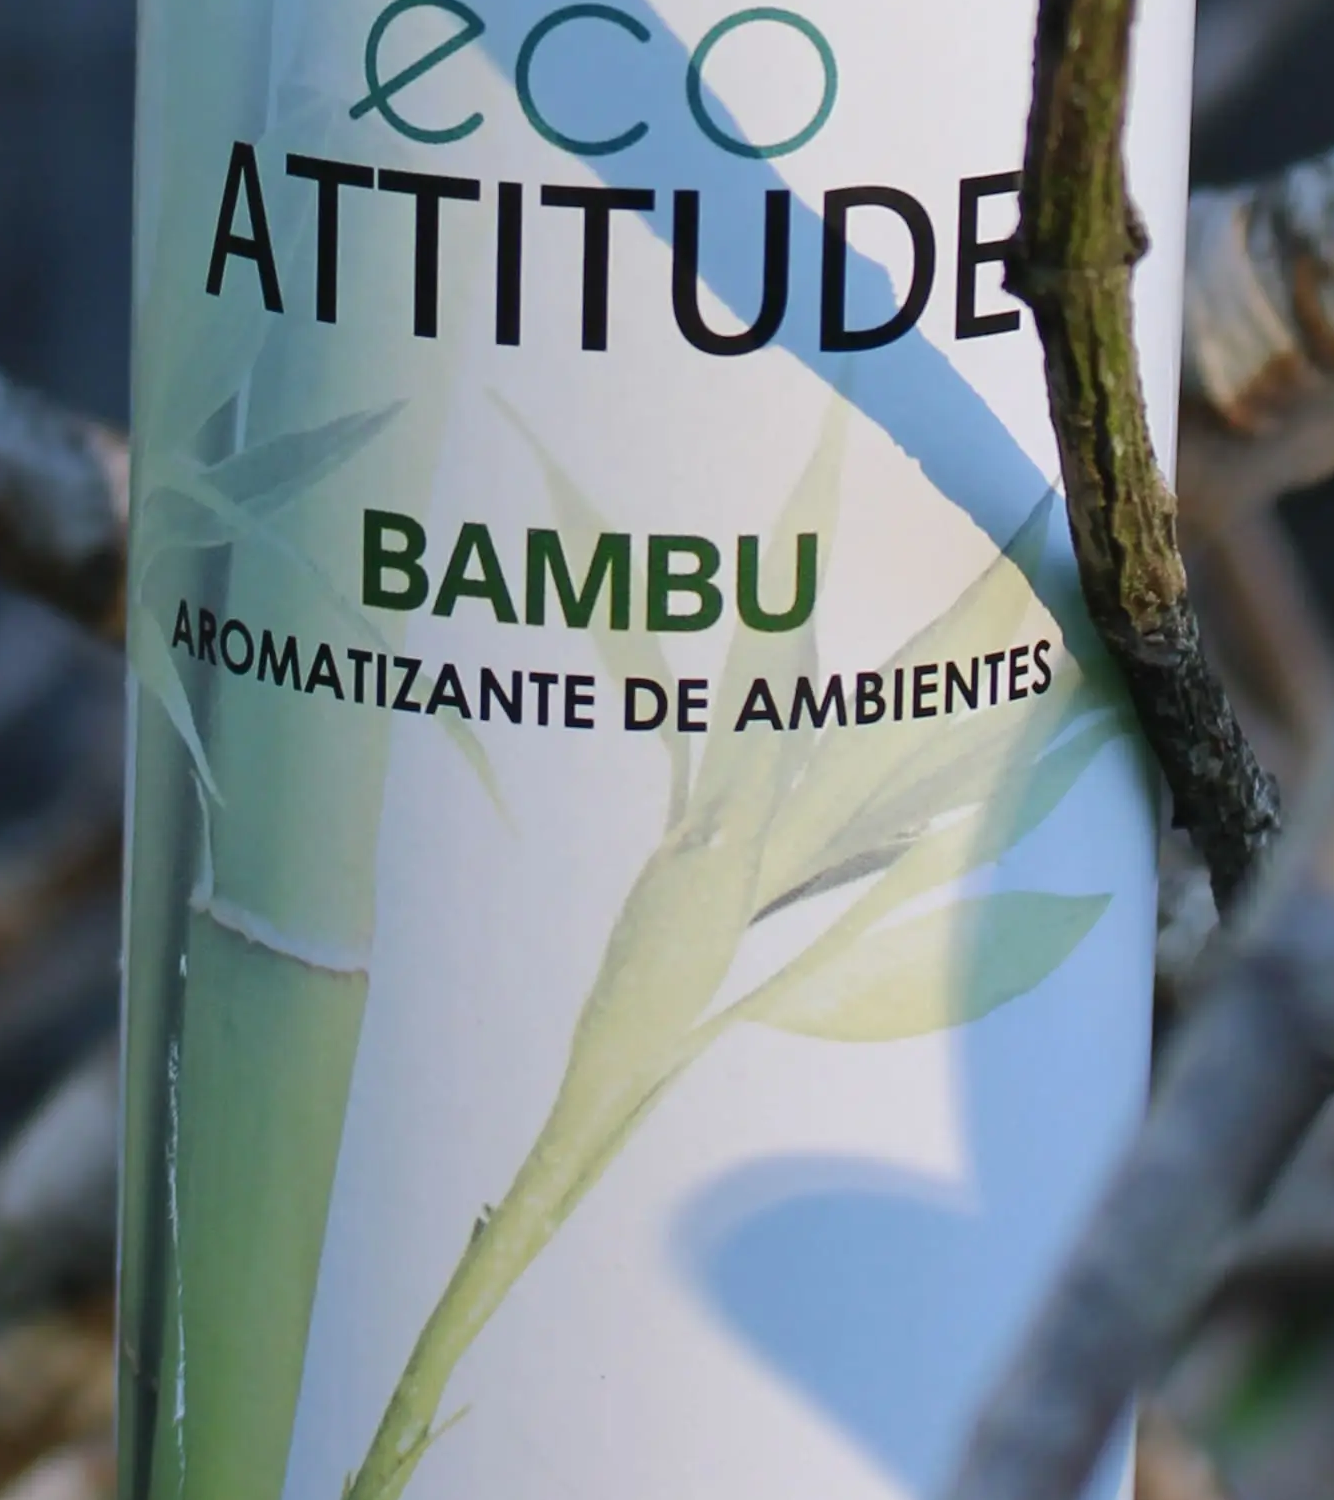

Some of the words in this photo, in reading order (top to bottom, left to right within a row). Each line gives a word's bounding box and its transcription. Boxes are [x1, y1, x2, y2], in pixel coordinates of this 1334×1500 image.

[205, 140, 1023, 357] ATTITUDE
[361, 508, 819, 634] BAMBU
[171, 598, 596, 730] AROMATIZANTE
[623, 677, 709, 733] DE
[733, 639, 1052, 733] AMBIENTES
